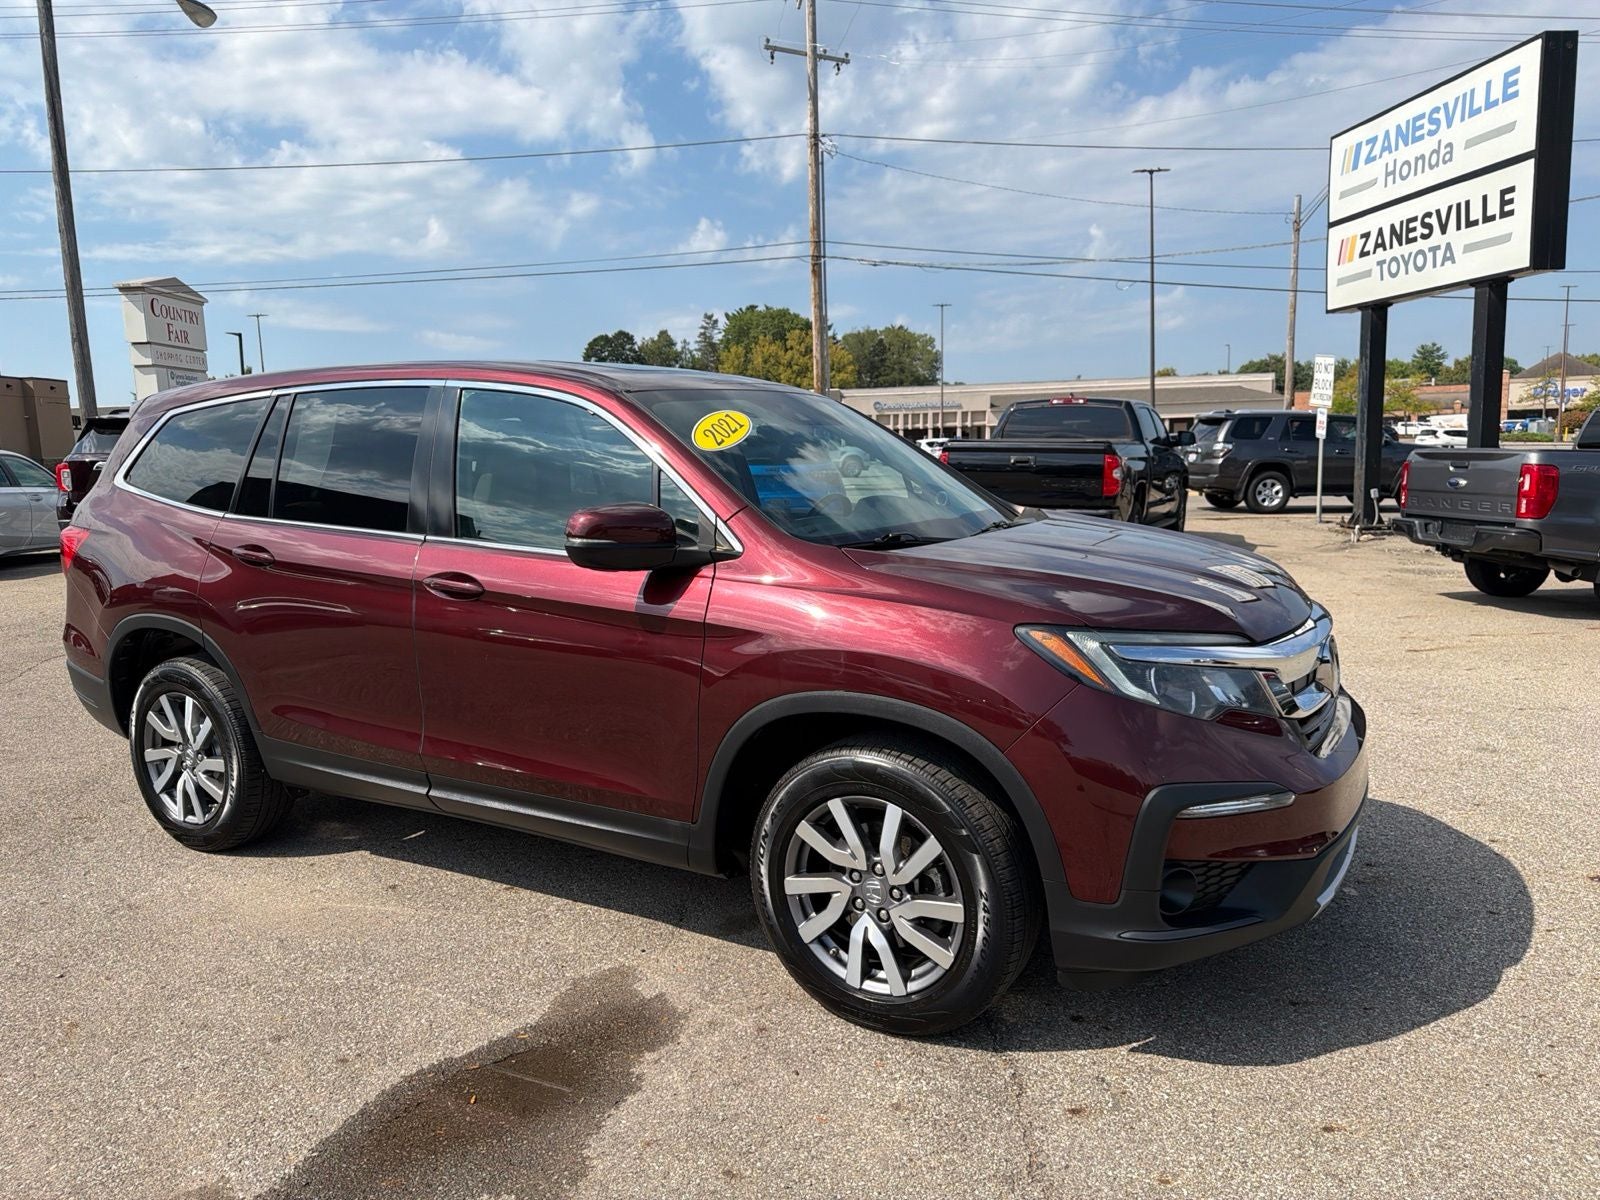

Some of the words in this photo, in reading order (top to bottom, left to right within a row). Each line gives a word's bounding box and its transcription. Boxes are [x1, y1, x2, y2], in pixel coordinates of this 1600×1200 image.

[1364, 65, 1521, 165] ZANESVILLE
[1384, 139, 1454, 188] Honda
[1359, 185, 1516, 259] ZANESVILLE
[1376, 242, 1456, 281] TOYOTA
[150, 297, 200, 325] COUNTRY
[166, 323, 190, 344] FAIR
[703, 413, 745, 446] 2021
[1409, 496, 1513, 513] RANGER
